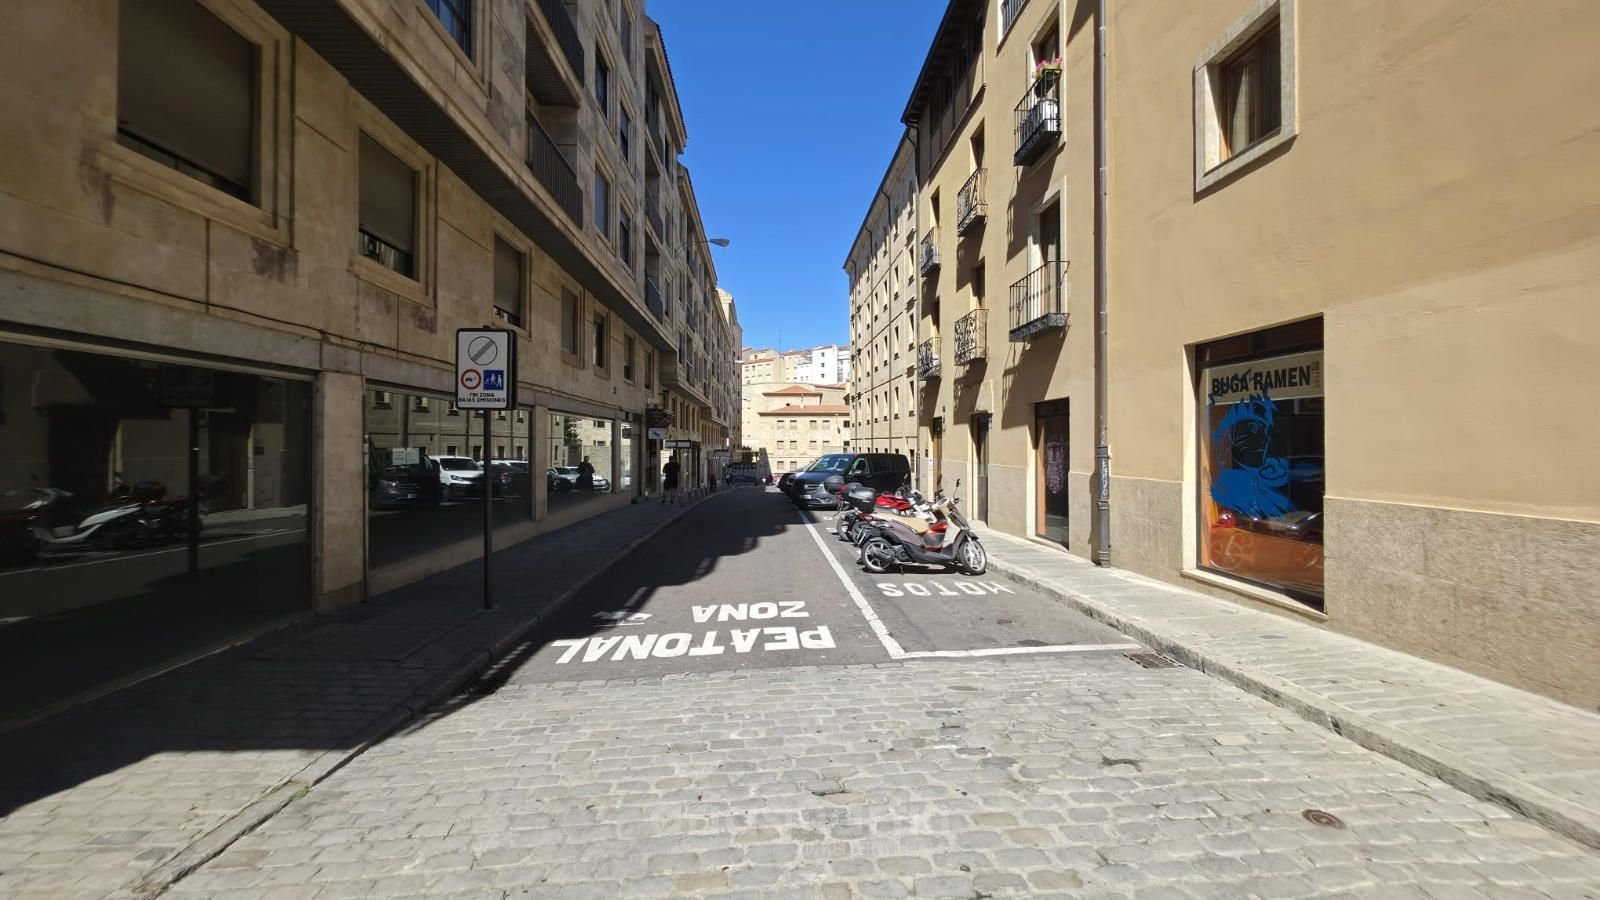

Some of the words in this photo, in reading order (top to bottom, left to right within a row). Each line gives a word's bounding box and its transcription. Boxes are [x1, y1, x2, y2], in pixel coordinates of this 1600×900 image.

[1211, 373, 1249, 396] BUGA
[1253, 365, 1311, 391] RAMEN
[876, 581, 1016, 597] MOTOS
[692, 601, 809, 623] ZONA
[551, 626, 836, 664] PEATONAL
